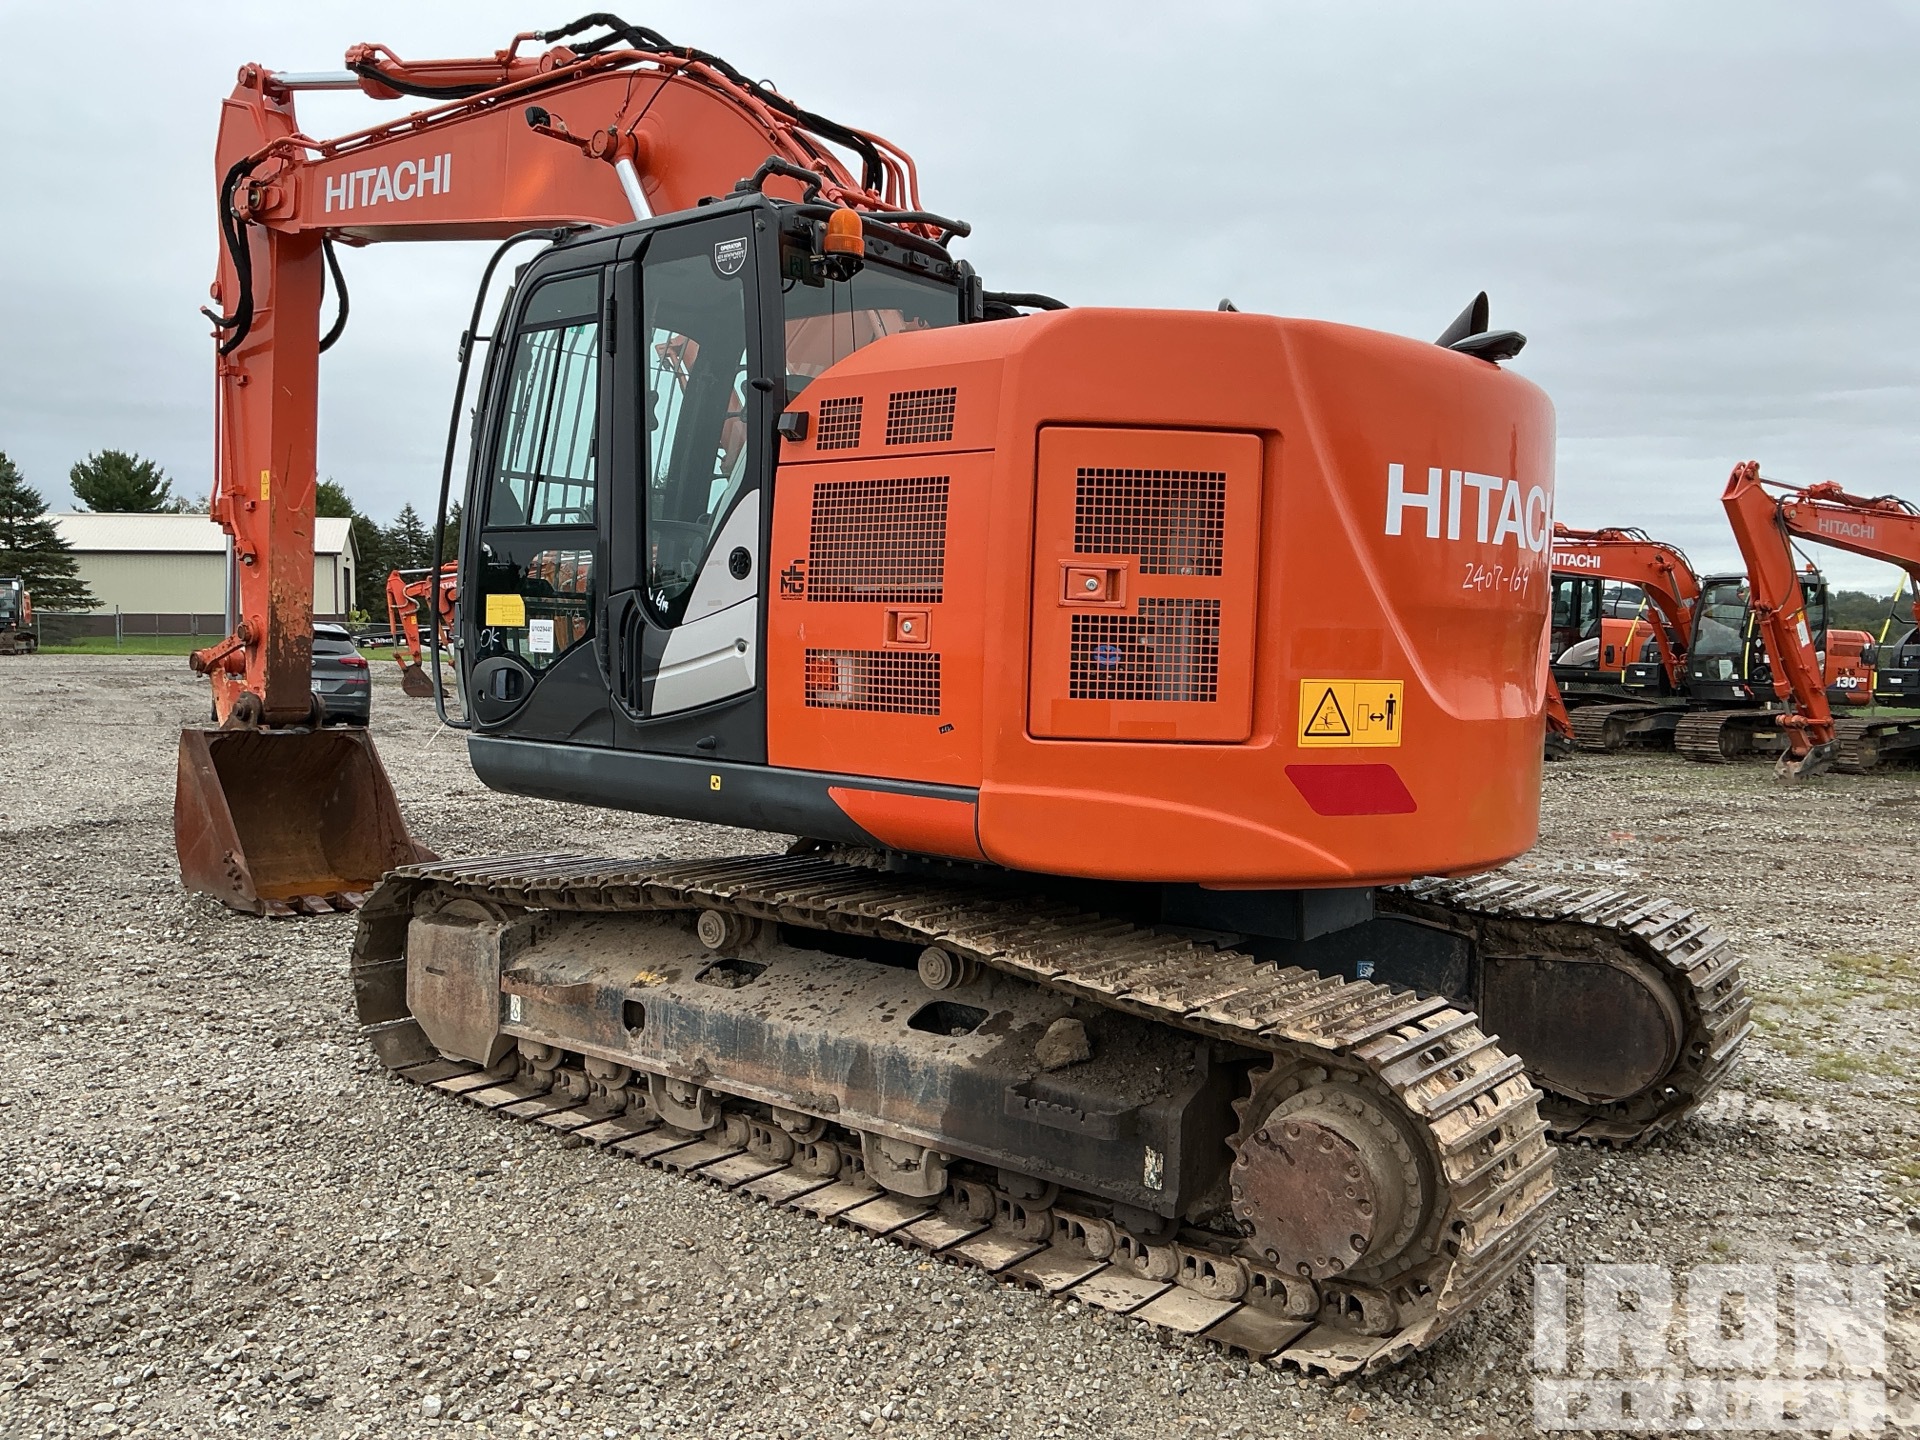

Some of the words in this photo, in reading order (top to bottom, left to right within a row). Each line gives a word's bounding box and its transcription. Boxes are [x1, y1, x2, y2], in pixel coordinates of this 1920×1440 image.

[325, 153, 452, 213] HITACHI
[1818, 518, 1875, 539] HITACHI
[1462, 563, 1530, 600] 2407-169
[1835, 676, 1858, 689] 130
